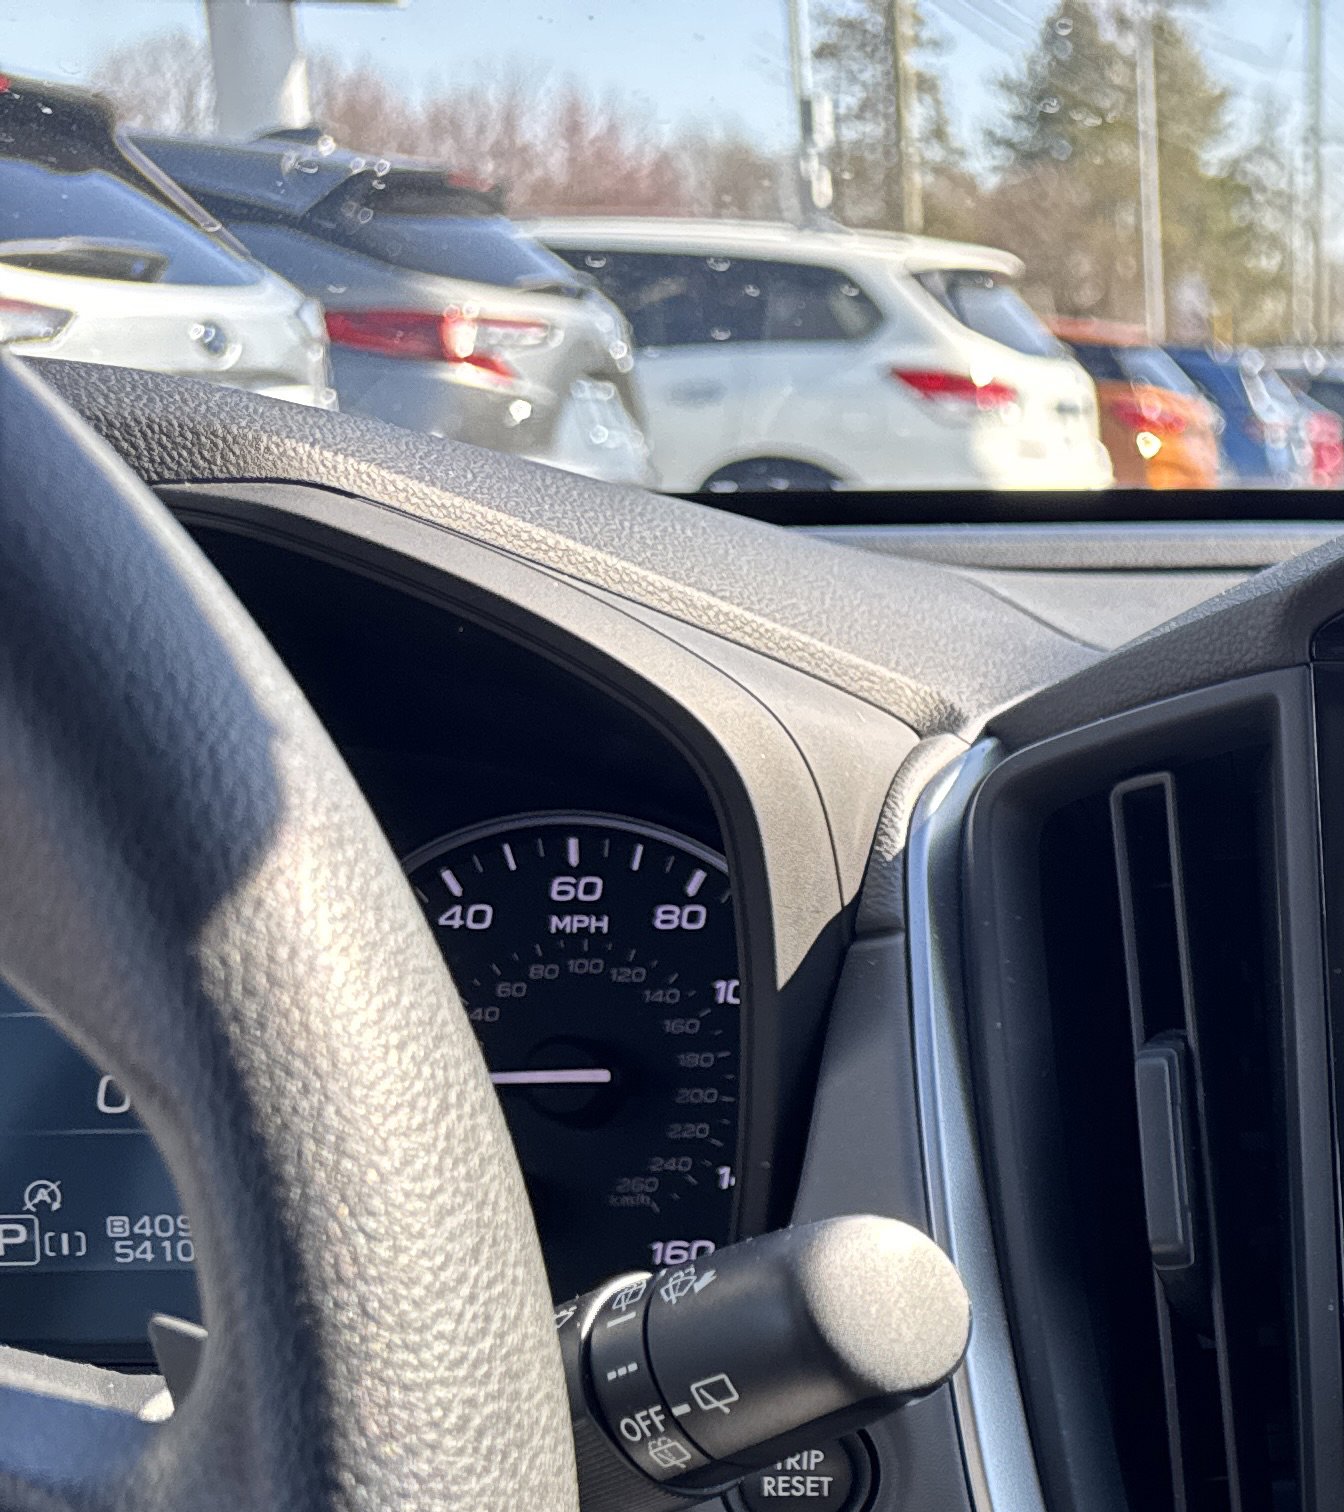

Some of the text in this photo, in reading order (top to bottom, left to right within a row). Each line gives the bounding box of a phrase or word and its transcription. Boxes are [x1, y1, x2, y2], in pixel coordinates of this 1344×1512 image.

[550, 876, 603, 901] 60
[438, 903, 493, 930] 40
[550, 914, 609, 934] MPH
[653, 904, 707, 930] 80
[529, 964, 560, 980] 80
[568, 958, 604, 974] 100
[610, 967, 647, 983] 120
[644, 988, 680, 1004] 140
[619, 1405, 665, 1442] OFF
[762, 1475, 834, 1497] RESET
